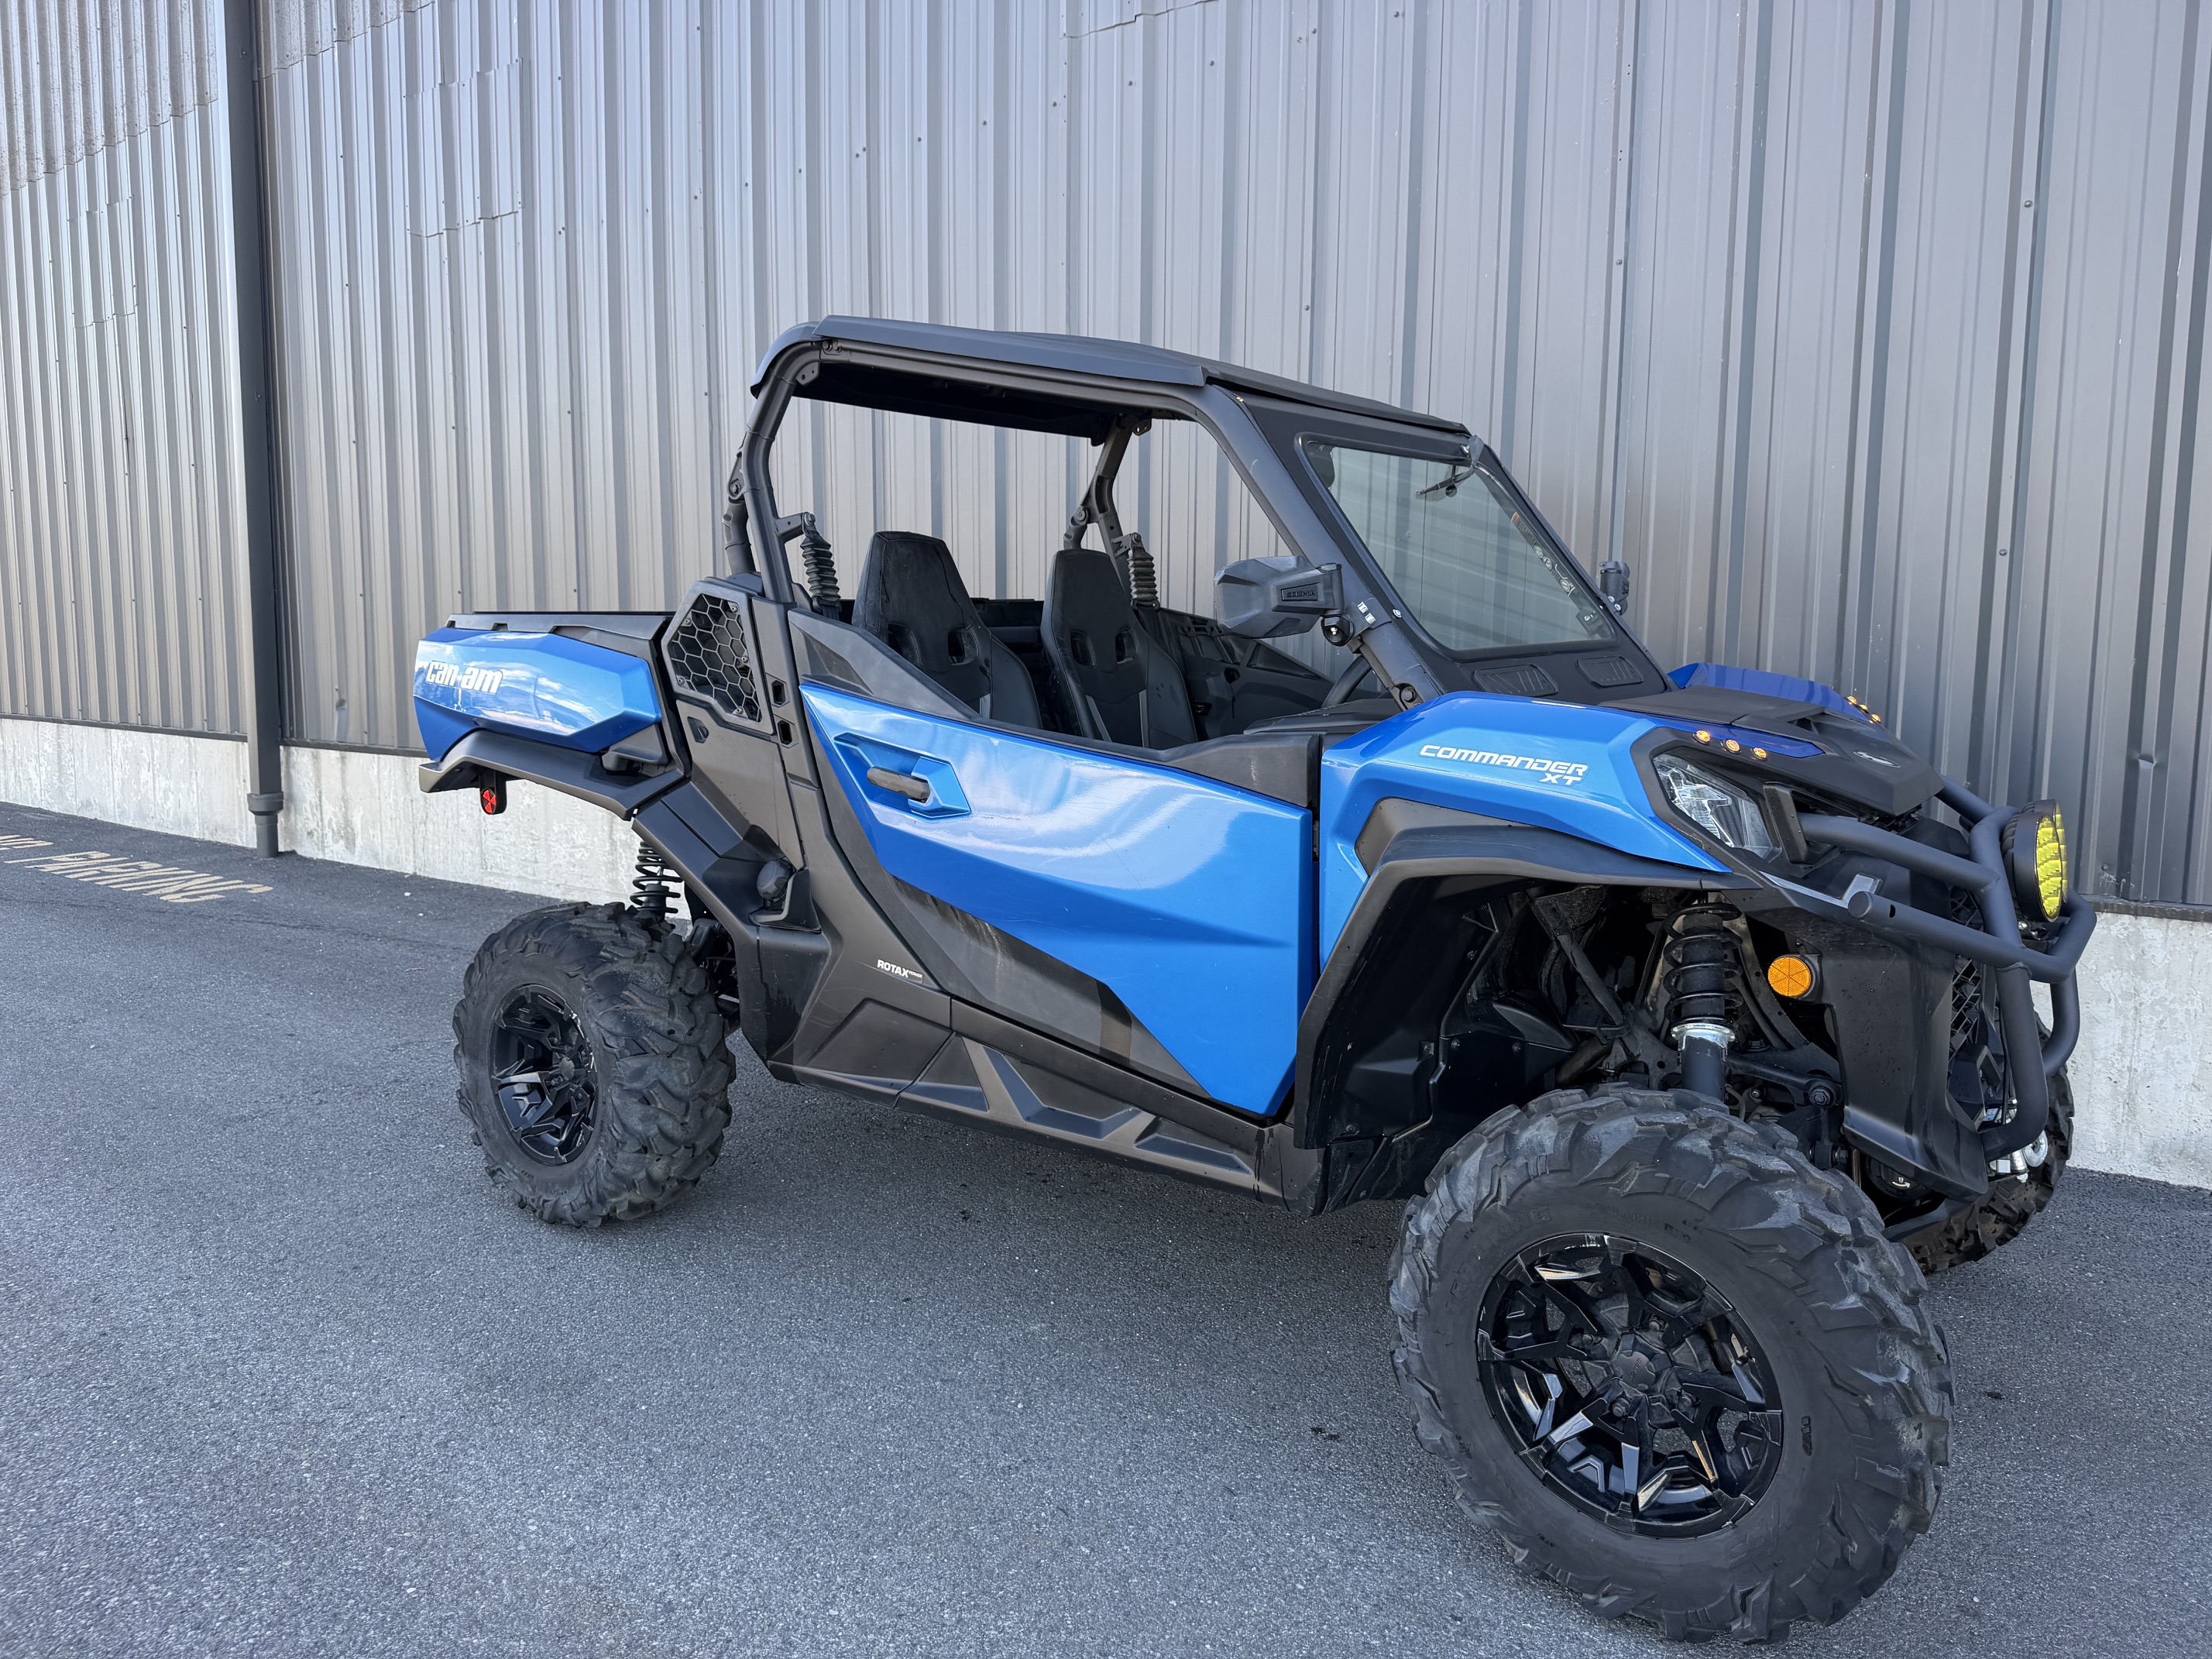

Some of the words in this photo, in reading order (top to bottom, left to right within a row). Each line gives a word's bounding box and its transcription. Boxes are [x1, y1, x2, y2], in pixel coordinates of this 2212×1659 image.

[426, 661, 503, 694] can-am
[1420, 744, 1588, 775] COMMANDER
[1539, 773, 1582, 785] XT
[4, 850, 273, 902] PARKING
[877, 959, 908, 978] ROTAX
